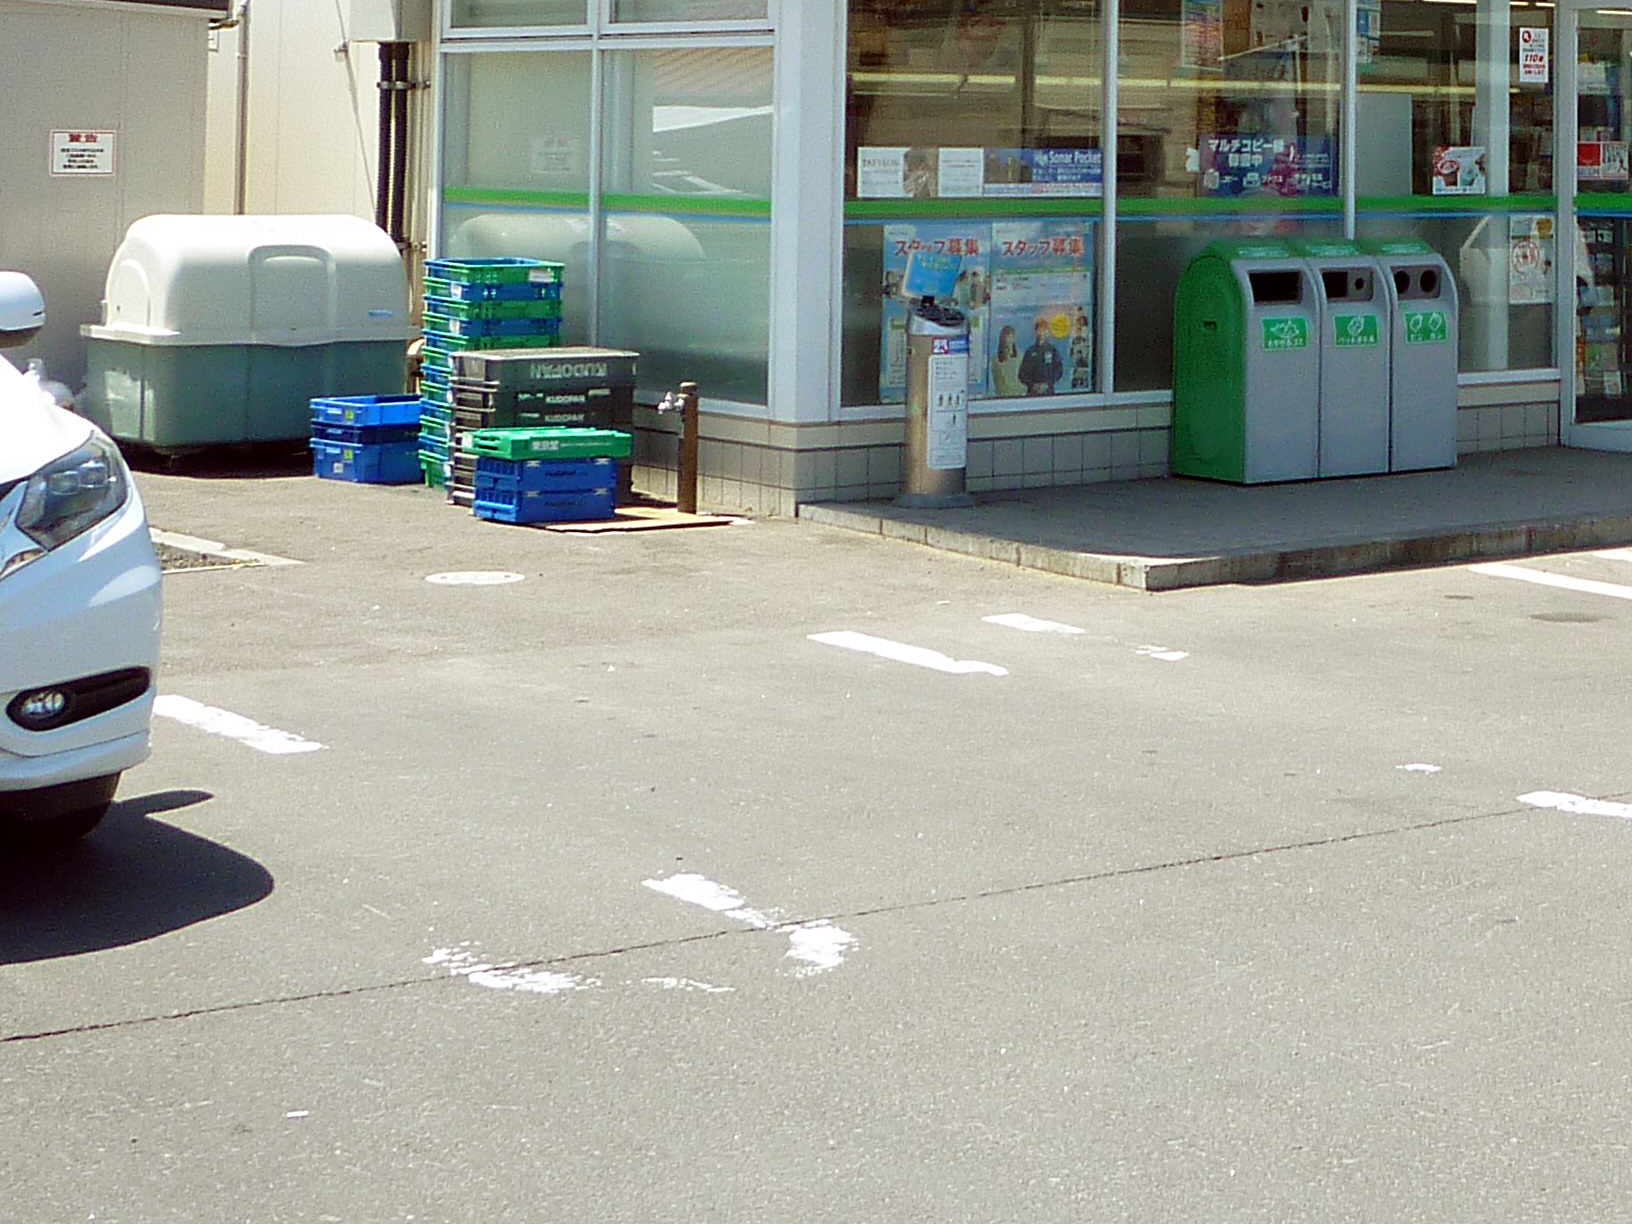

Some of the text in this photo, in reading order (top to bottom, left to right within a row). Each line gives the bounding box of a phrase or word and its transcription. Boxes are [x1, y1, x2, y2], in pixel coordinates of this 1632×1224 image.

[1001, 236, 1085, 257] スタッフ募集
